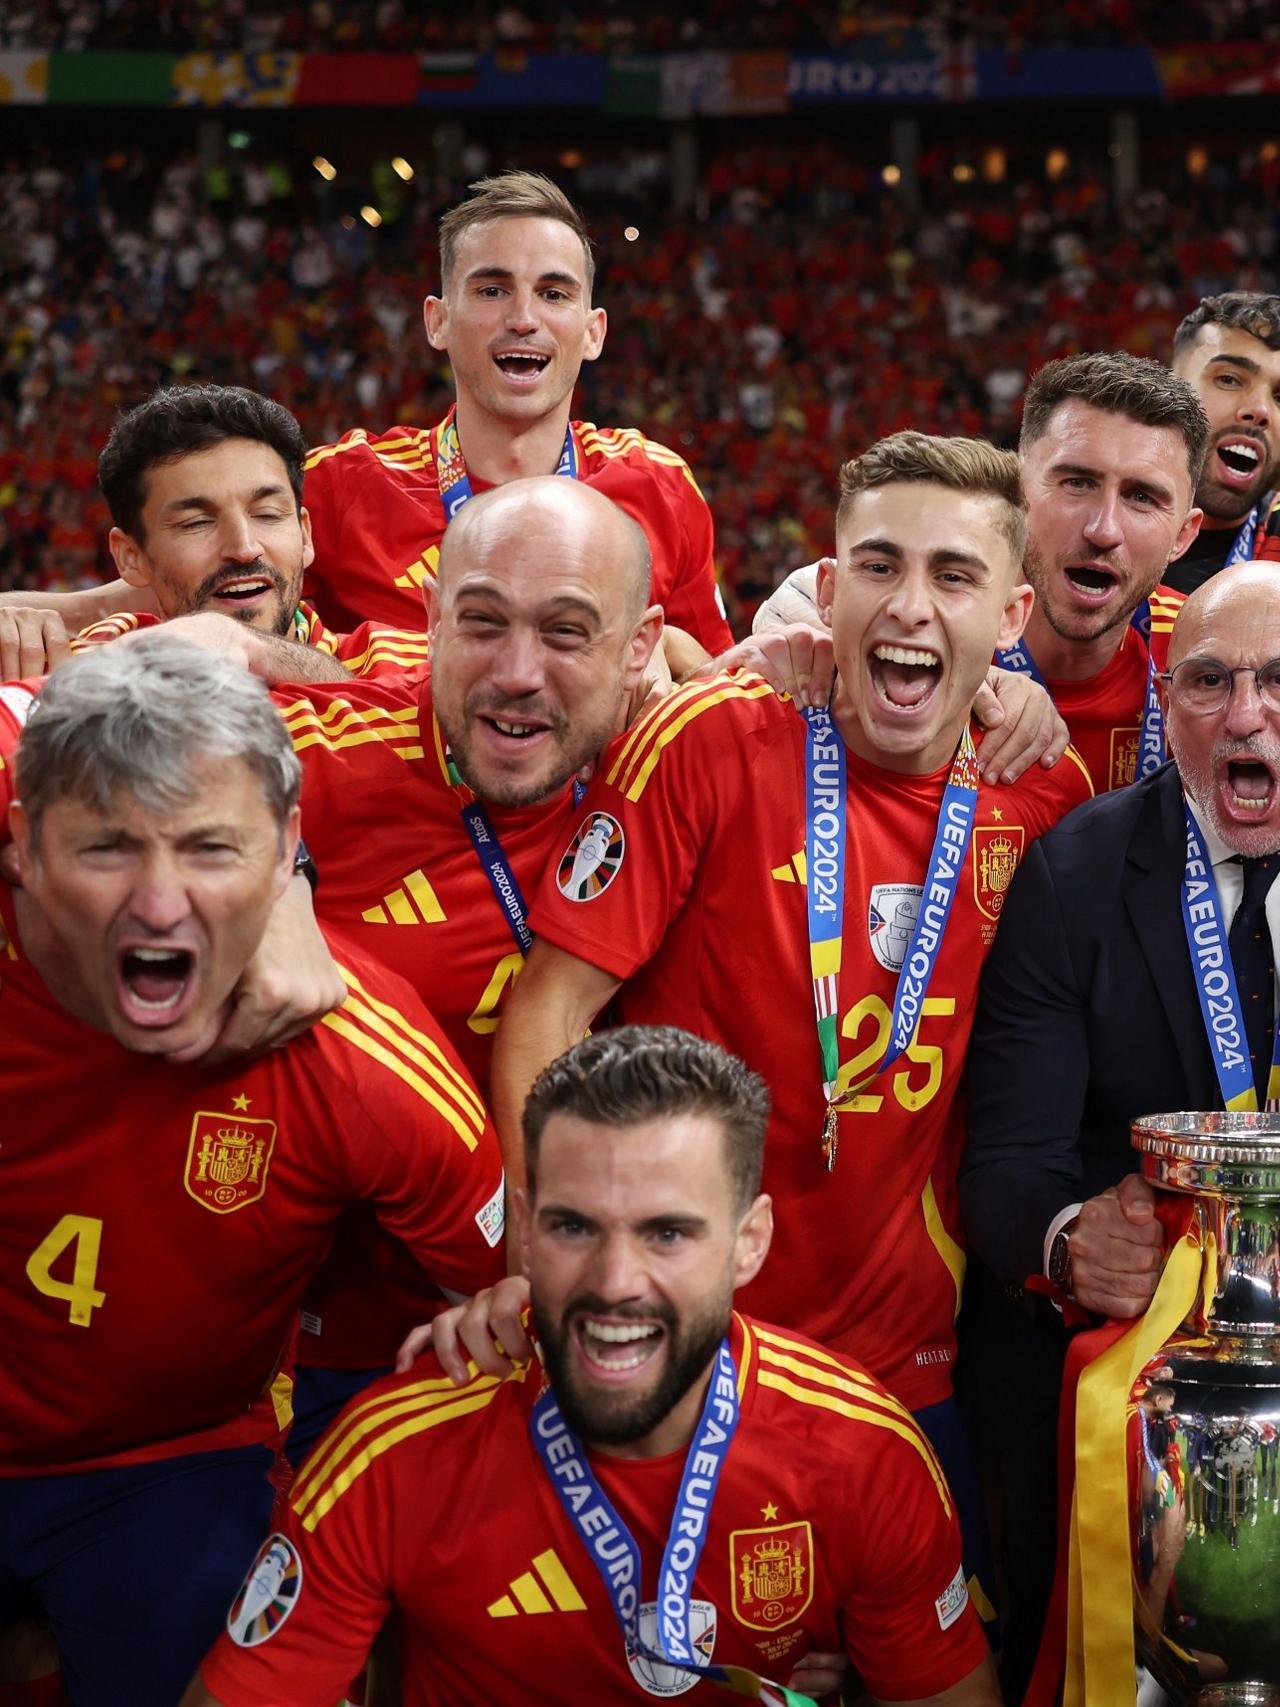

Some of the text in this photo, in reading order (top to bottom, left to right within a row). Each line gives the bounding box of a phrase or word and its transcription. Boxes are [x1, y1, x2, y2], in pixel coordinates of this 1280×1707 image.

[832, 994, 956, 1113] 25
[26, 1214, 106, 1328] 4
[663, 1346, 736, 1661] UEFAEURO2024
